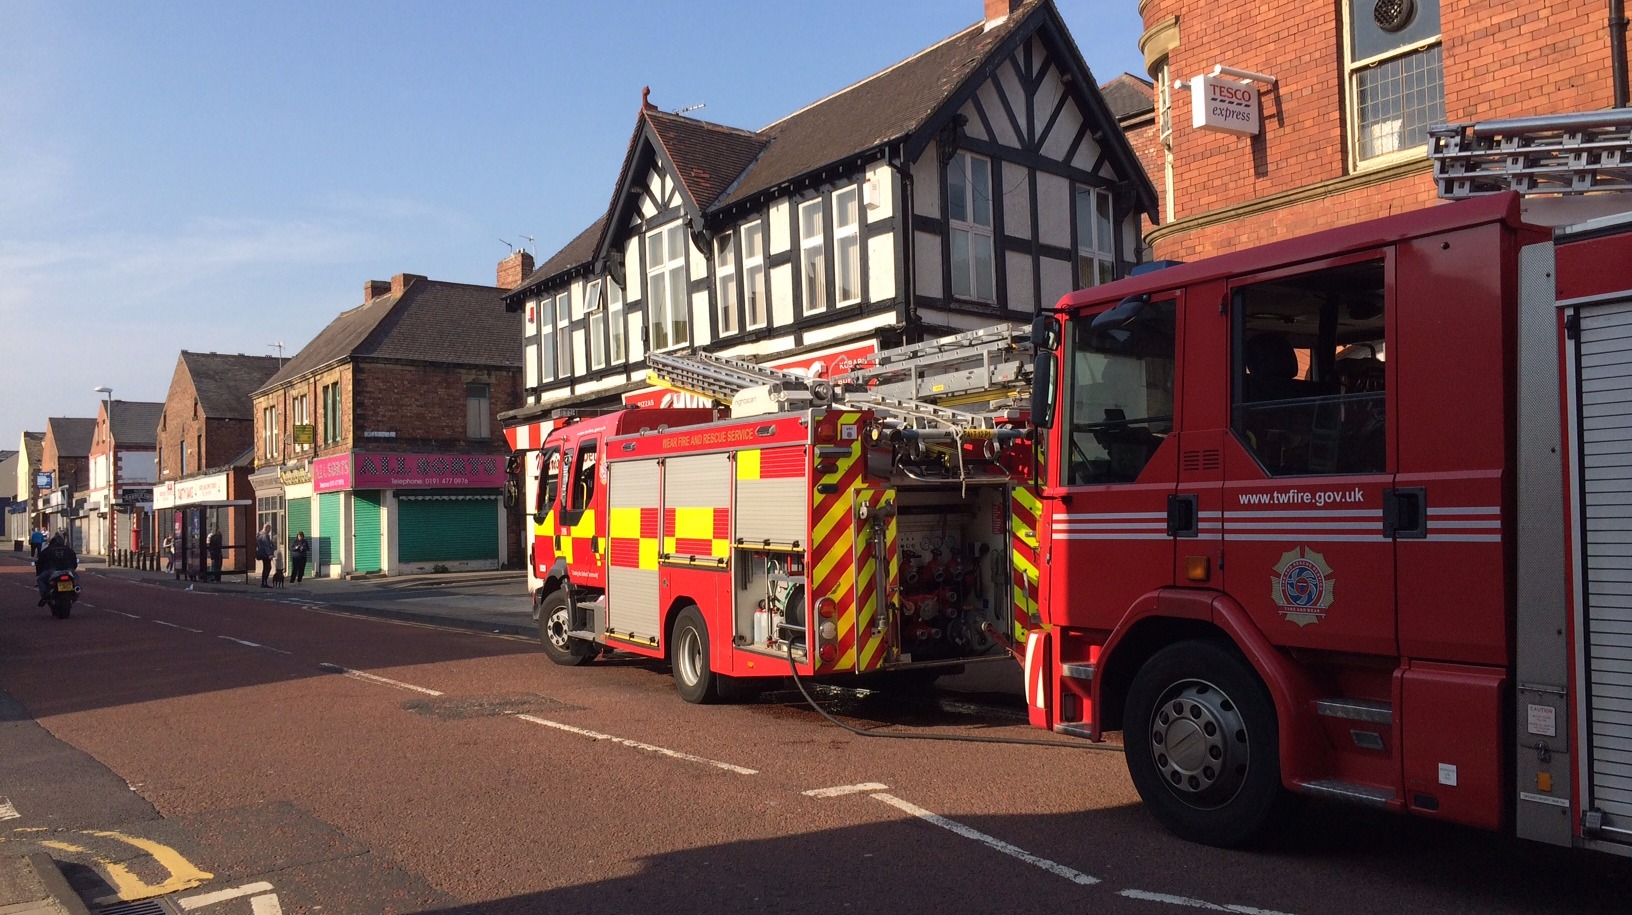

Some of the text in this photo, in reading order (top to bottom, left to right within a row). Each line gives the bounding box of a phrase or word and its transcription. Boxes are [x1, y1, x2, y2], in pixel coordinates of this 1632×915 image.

[1210, 84, 1251, 102] TESCO
[1213, 105, 1251, 121] express
[663, 428, 754, 448] WEAR FIRE AND RESCUE SERVICE
[359, 457, 497, 475] ALL SORTS
[1239, 488, 1364, 506] www.twfire.gov.uk
[1529, 706, 1553, 714] CAUTION
